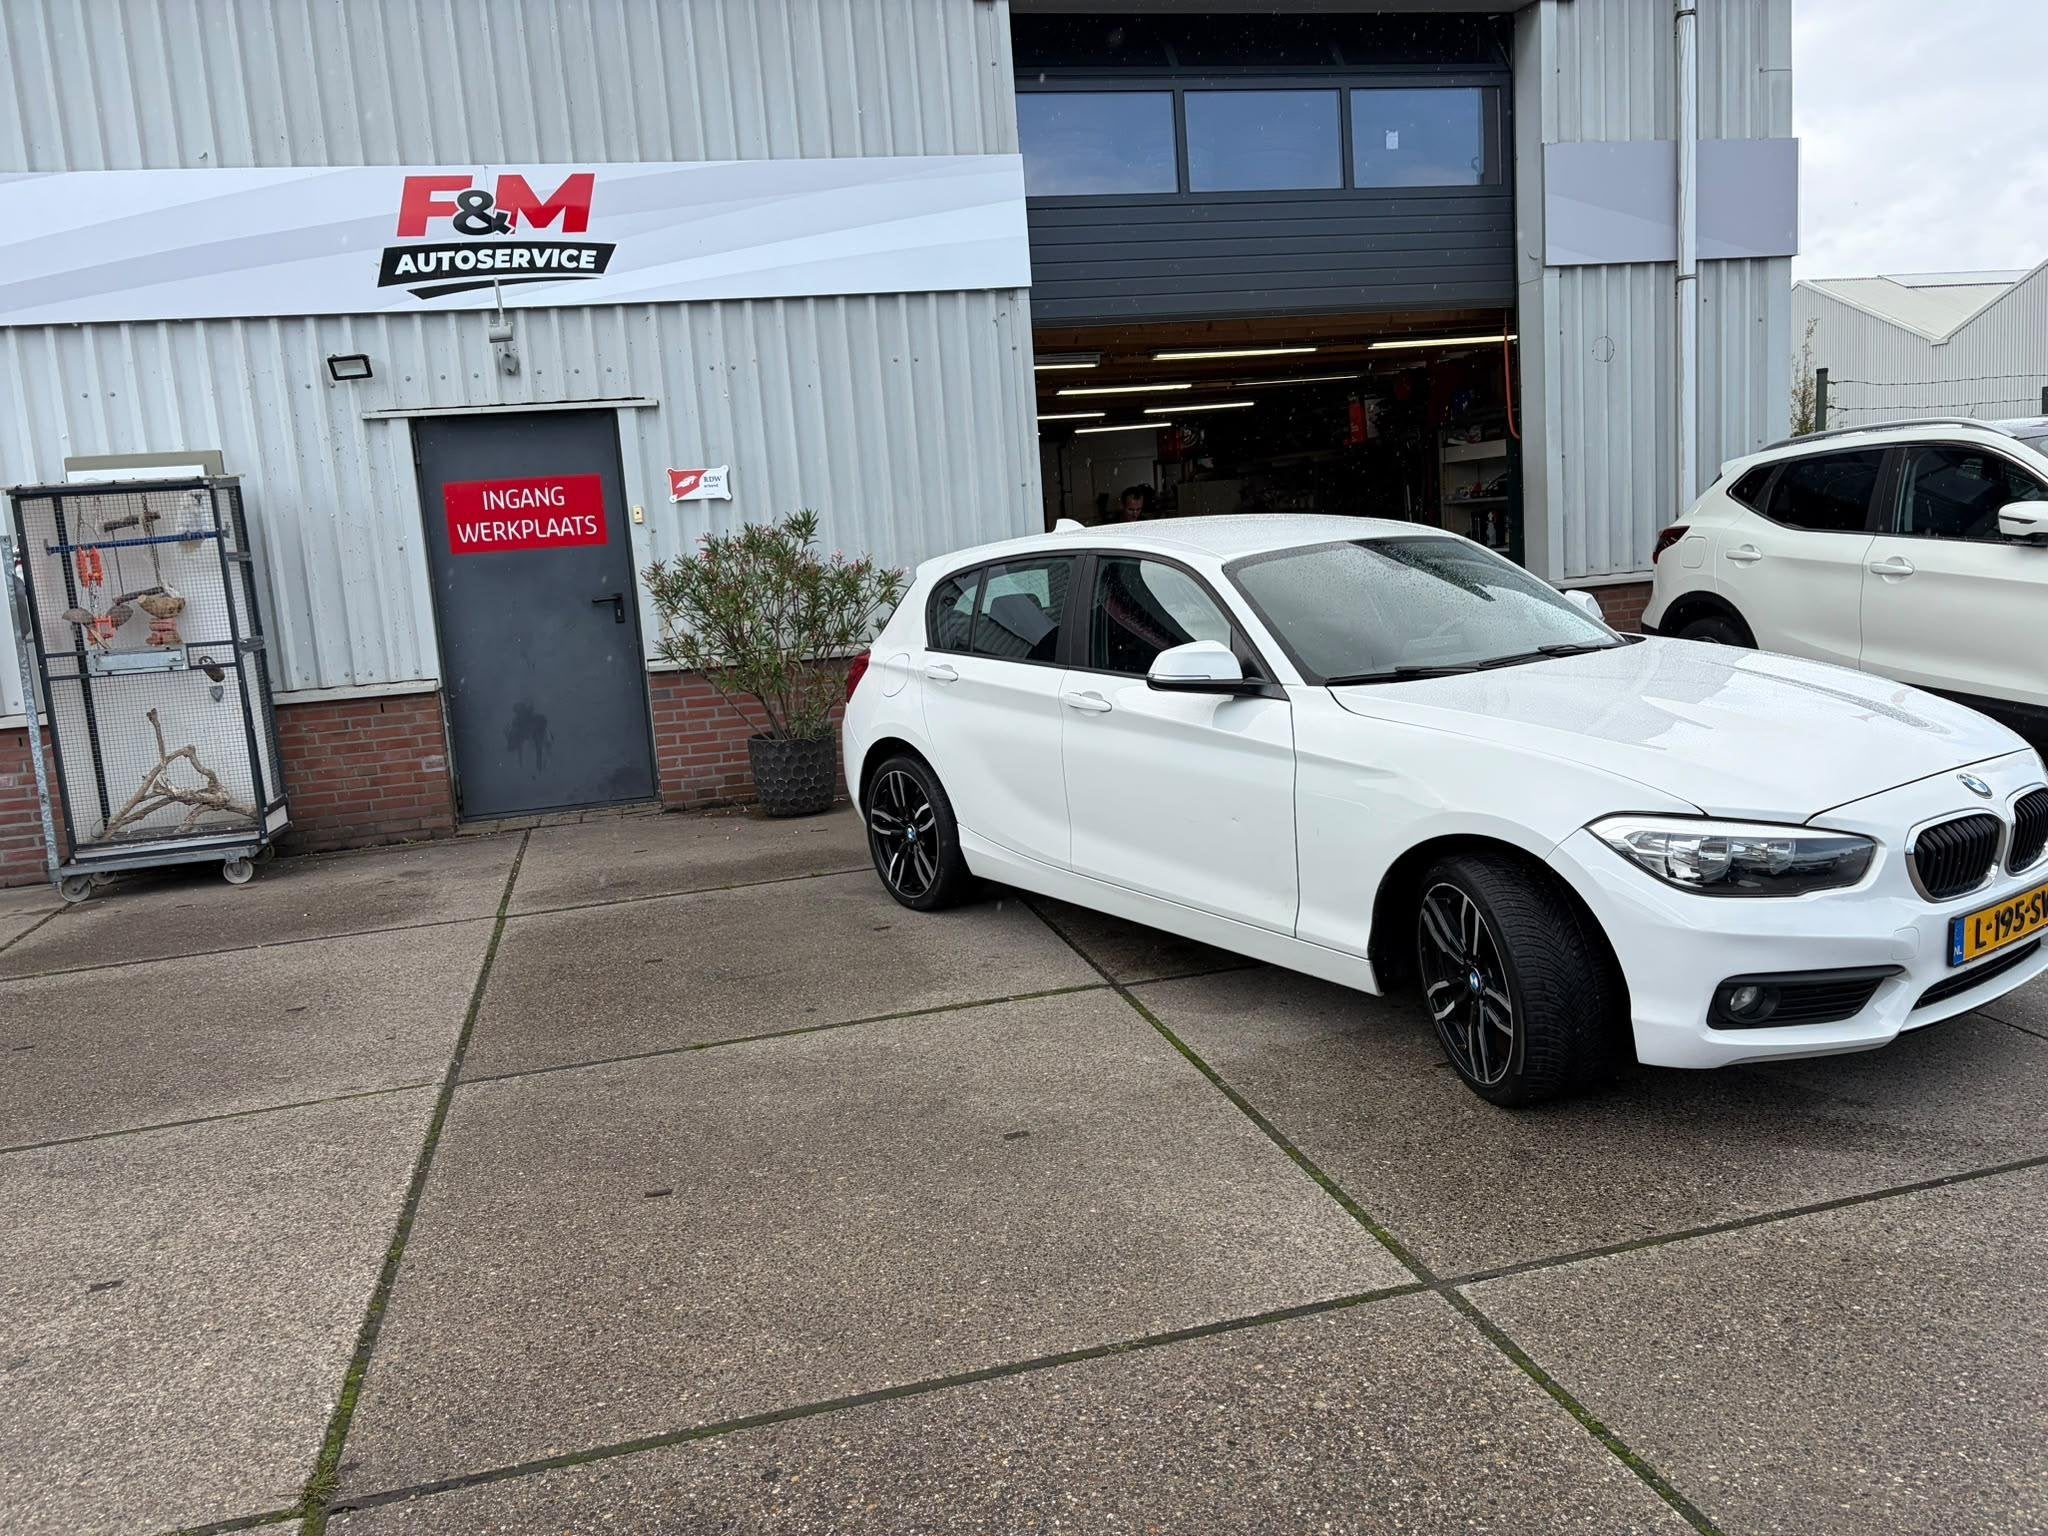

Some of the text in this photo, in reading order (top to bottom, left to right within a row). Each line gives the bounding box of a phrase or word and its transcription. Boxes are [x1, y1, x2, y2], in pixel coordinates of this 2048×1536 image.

[397, 173, 595, 237] F&M
[395, 248, 597, 275] AUTOSERVICE
[482, 486, 565, 511] INGANG
[456, 515, 598, 543] WERKPLAATS
